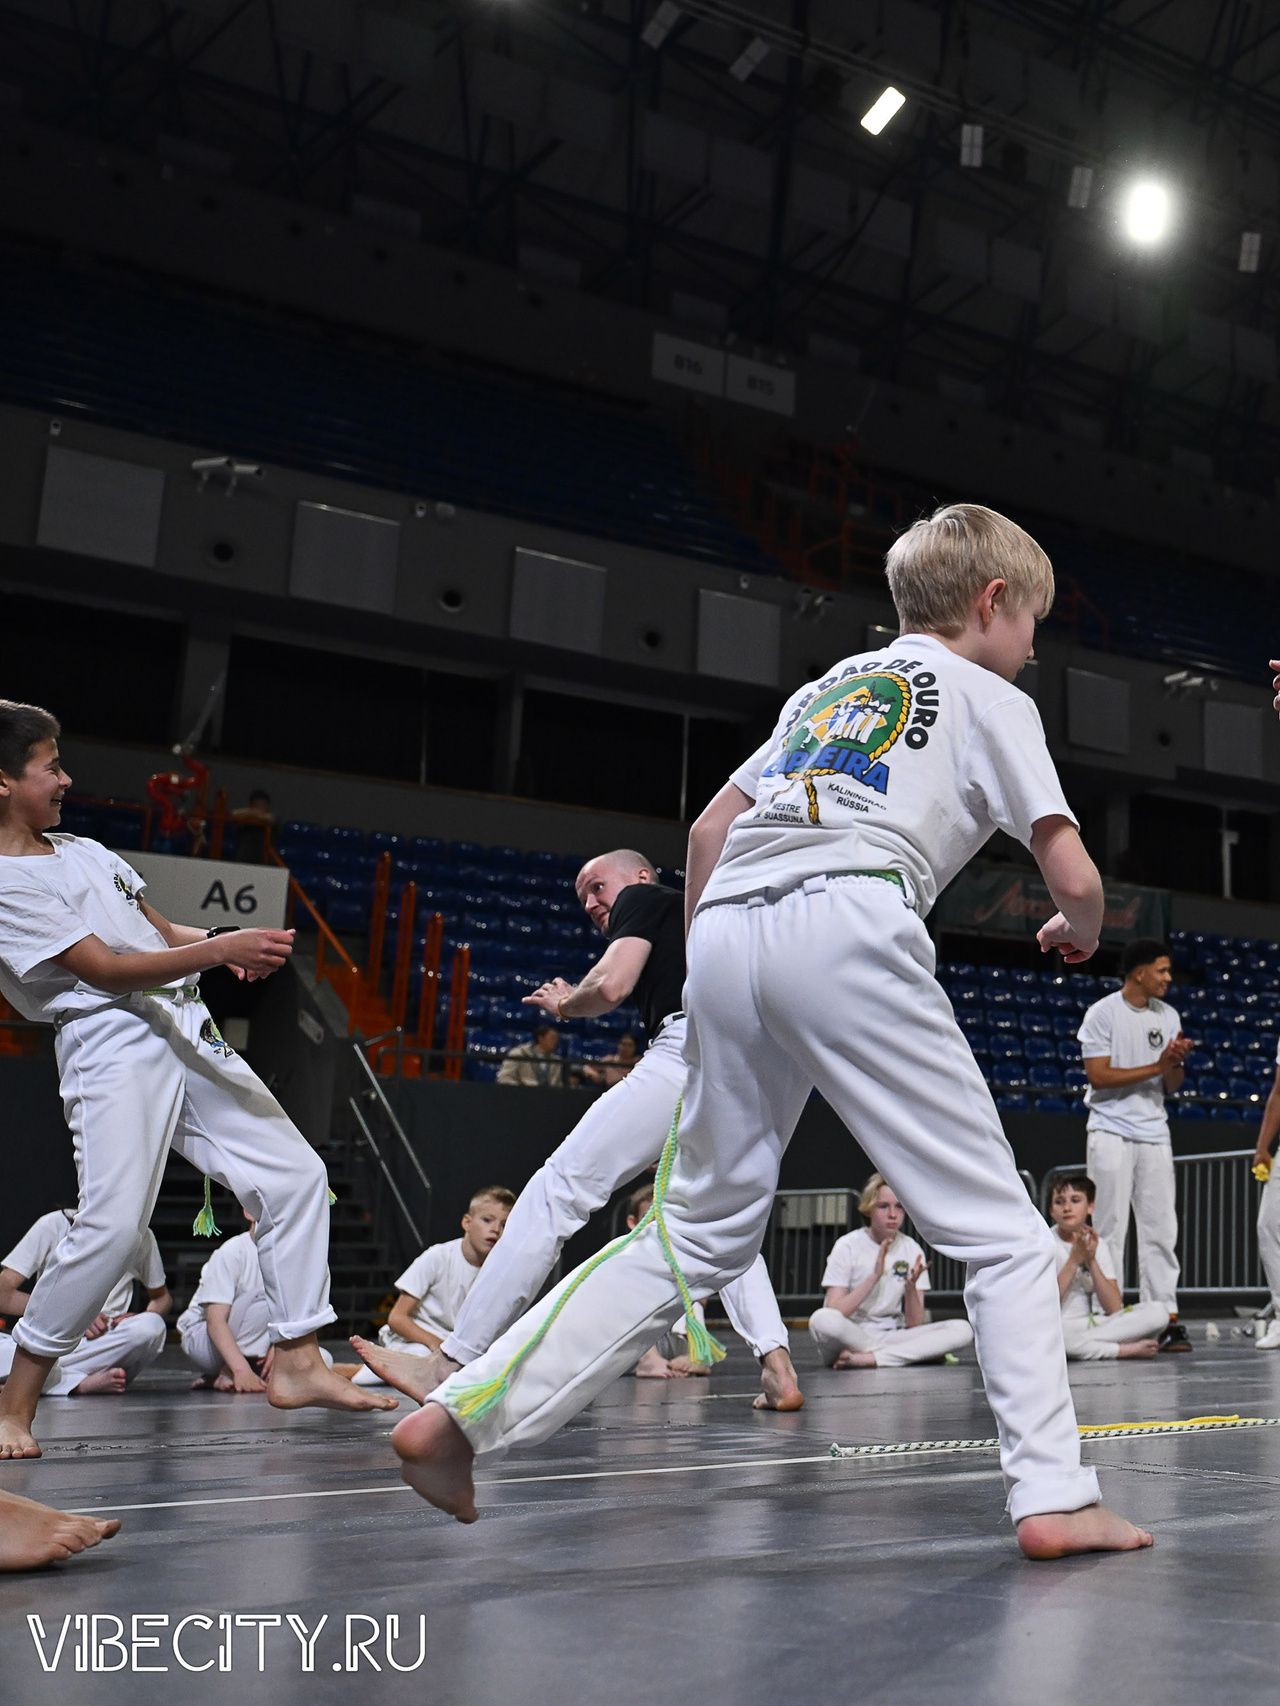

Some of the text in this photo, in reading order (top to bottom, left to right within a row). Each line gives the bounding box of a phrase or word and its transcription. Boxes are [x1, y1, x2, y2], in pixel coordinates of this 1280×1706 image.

[882, 658, 923, 673] DE
[904, 671, 940, 750] OURO
[761, 744, 890, 796] APEIRA
[827, 782, 887, 811] KALININGRAD
[836, 795, 869, 813] RÚSSIA
[201, 880, 258, 914] A6
